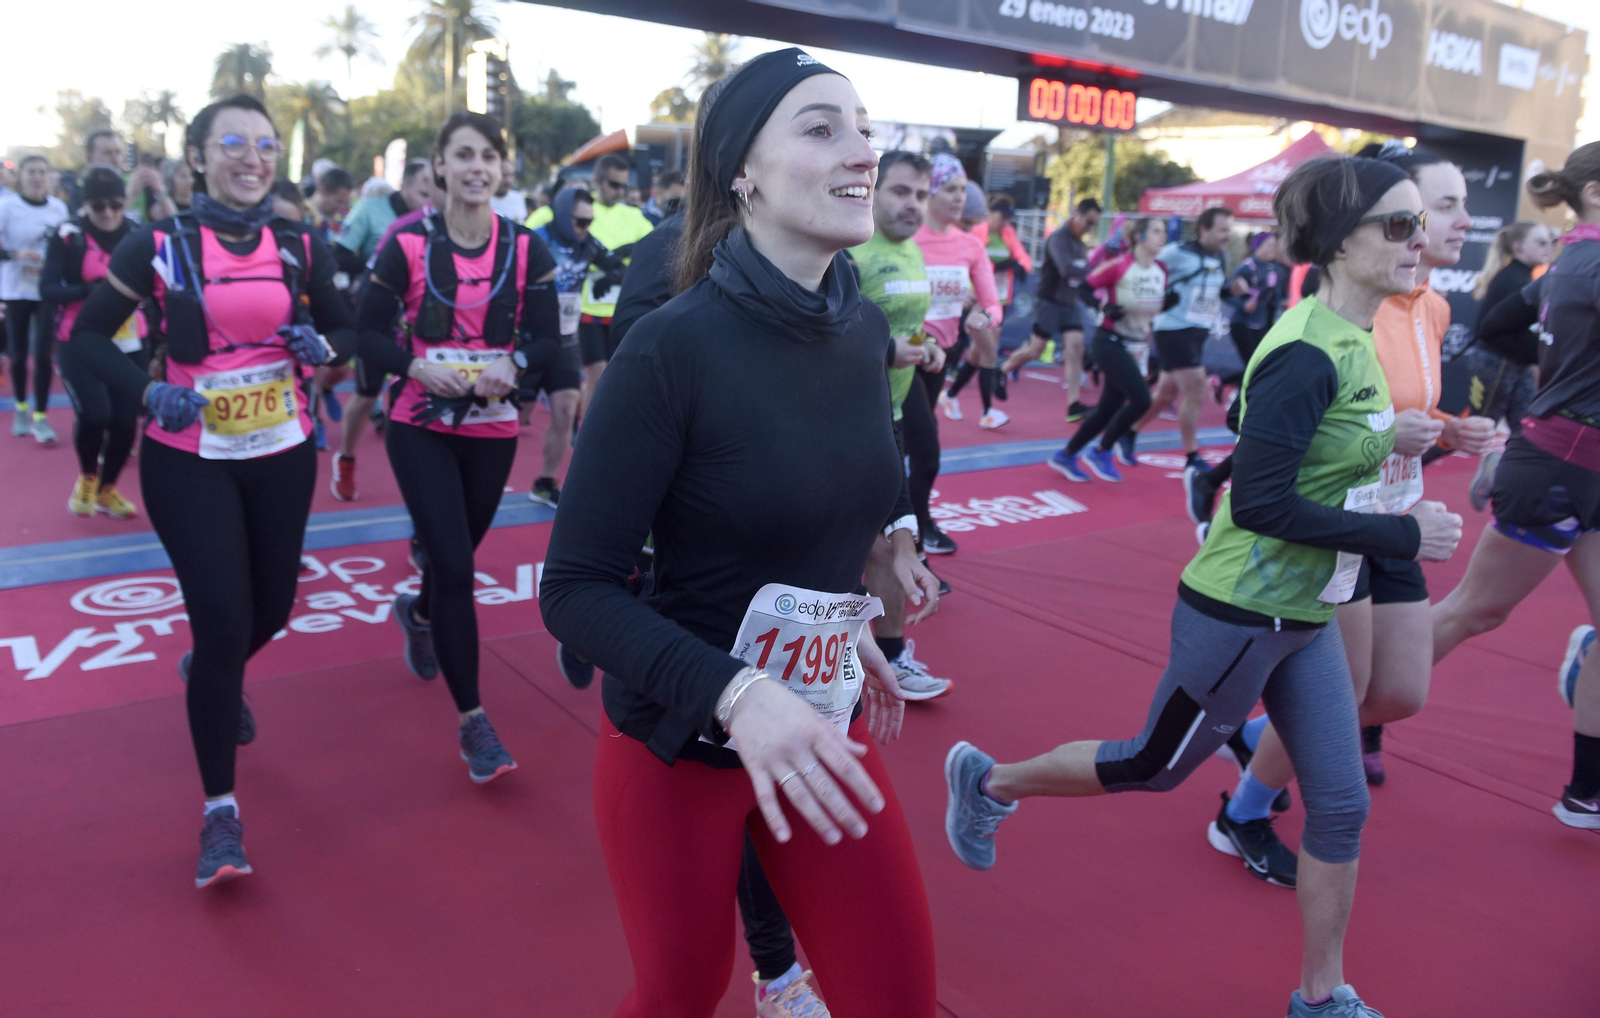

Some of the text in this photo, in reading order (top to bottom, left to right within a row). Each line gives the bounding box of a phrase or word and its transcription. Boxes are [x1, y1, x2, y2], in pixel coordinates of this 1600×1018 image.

[1029, 1, 1087, 31] enero
[1090, 7, 1135, 41] 2023
[1338, 0, 1394, 61] edp
[1425, 28, 1483, 77] HOKA
[215, 387, 277, 422] 9276
[798, 599, 825, 621] edp
[755, 627, 849, 687] 11997
